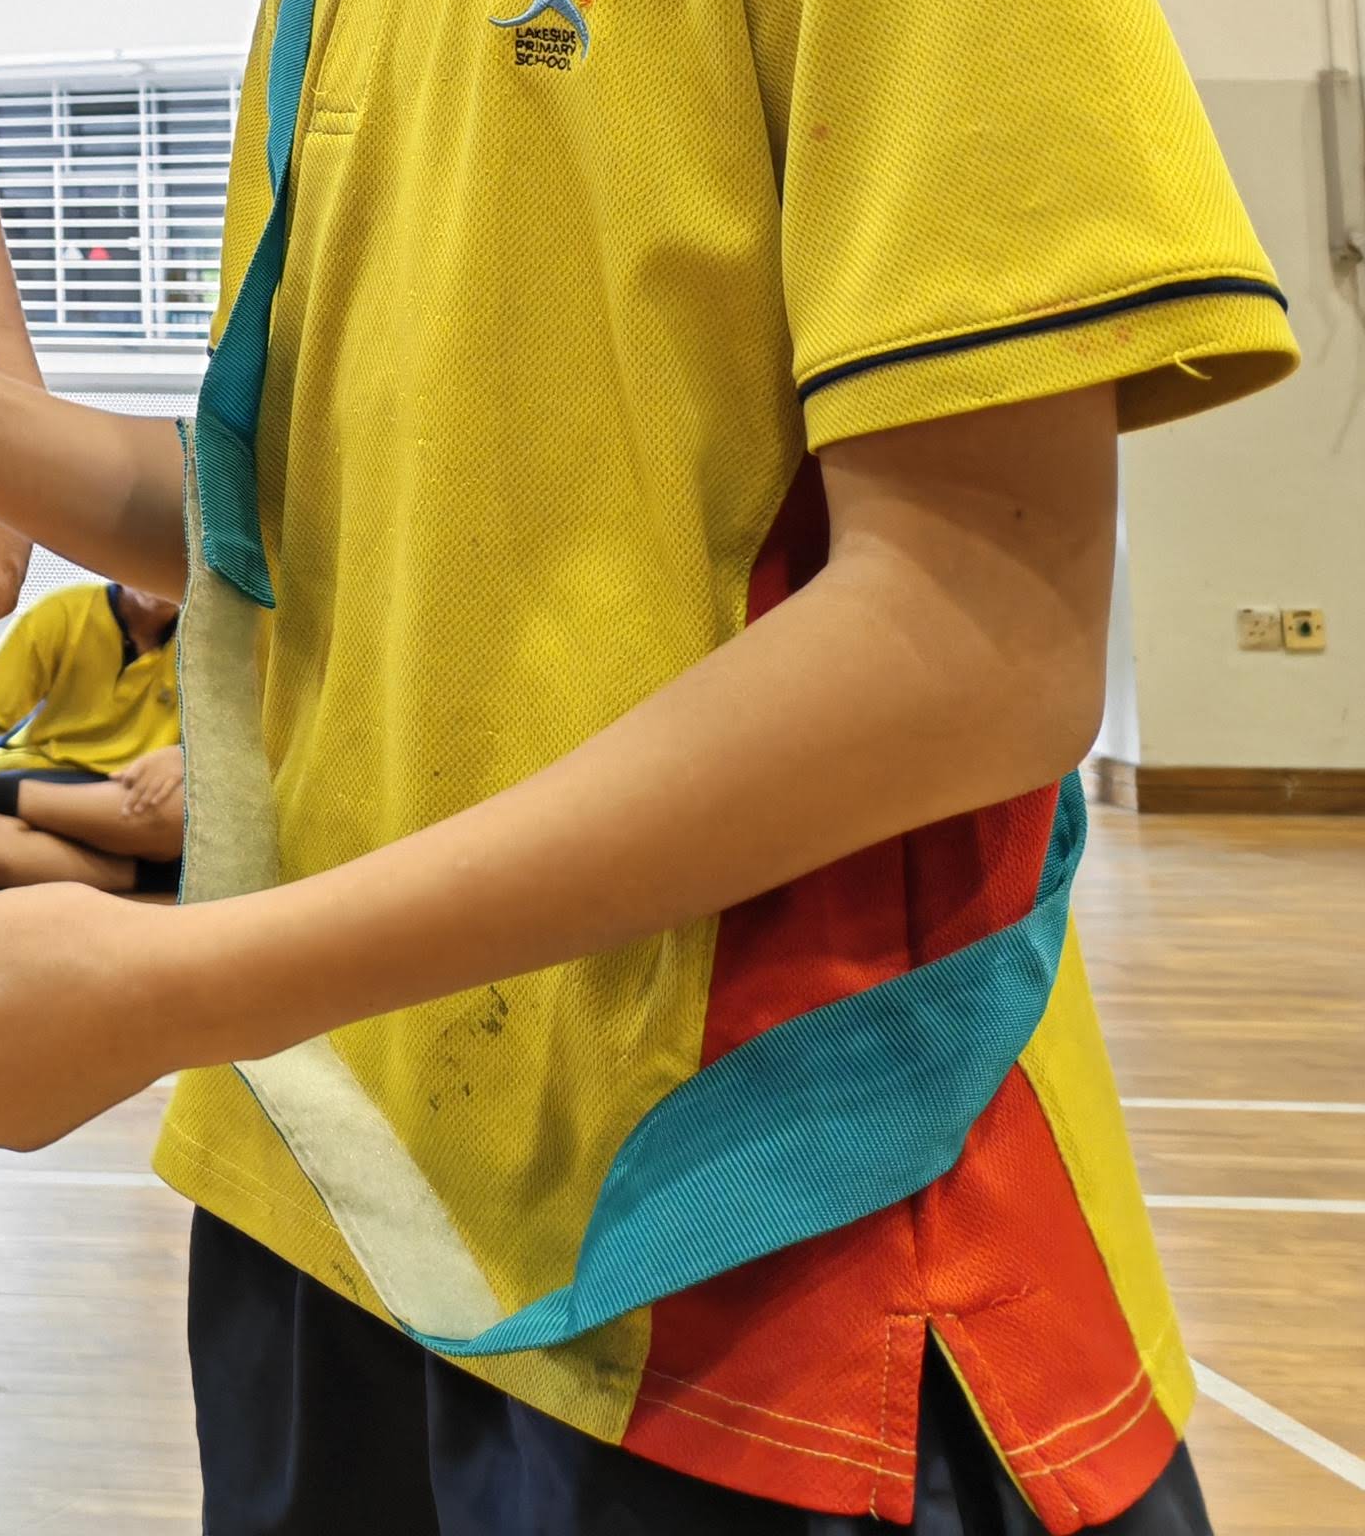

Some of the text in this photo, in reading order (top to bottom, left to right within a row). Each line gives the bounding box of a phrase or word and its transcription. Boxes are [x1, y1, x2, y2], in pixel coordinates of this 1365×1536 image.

[516, 27, 576, 44] LAKESIDE
[515, 39, 577, 56] PRIMARY
[514, 52, 572, 71] SCHOOL
